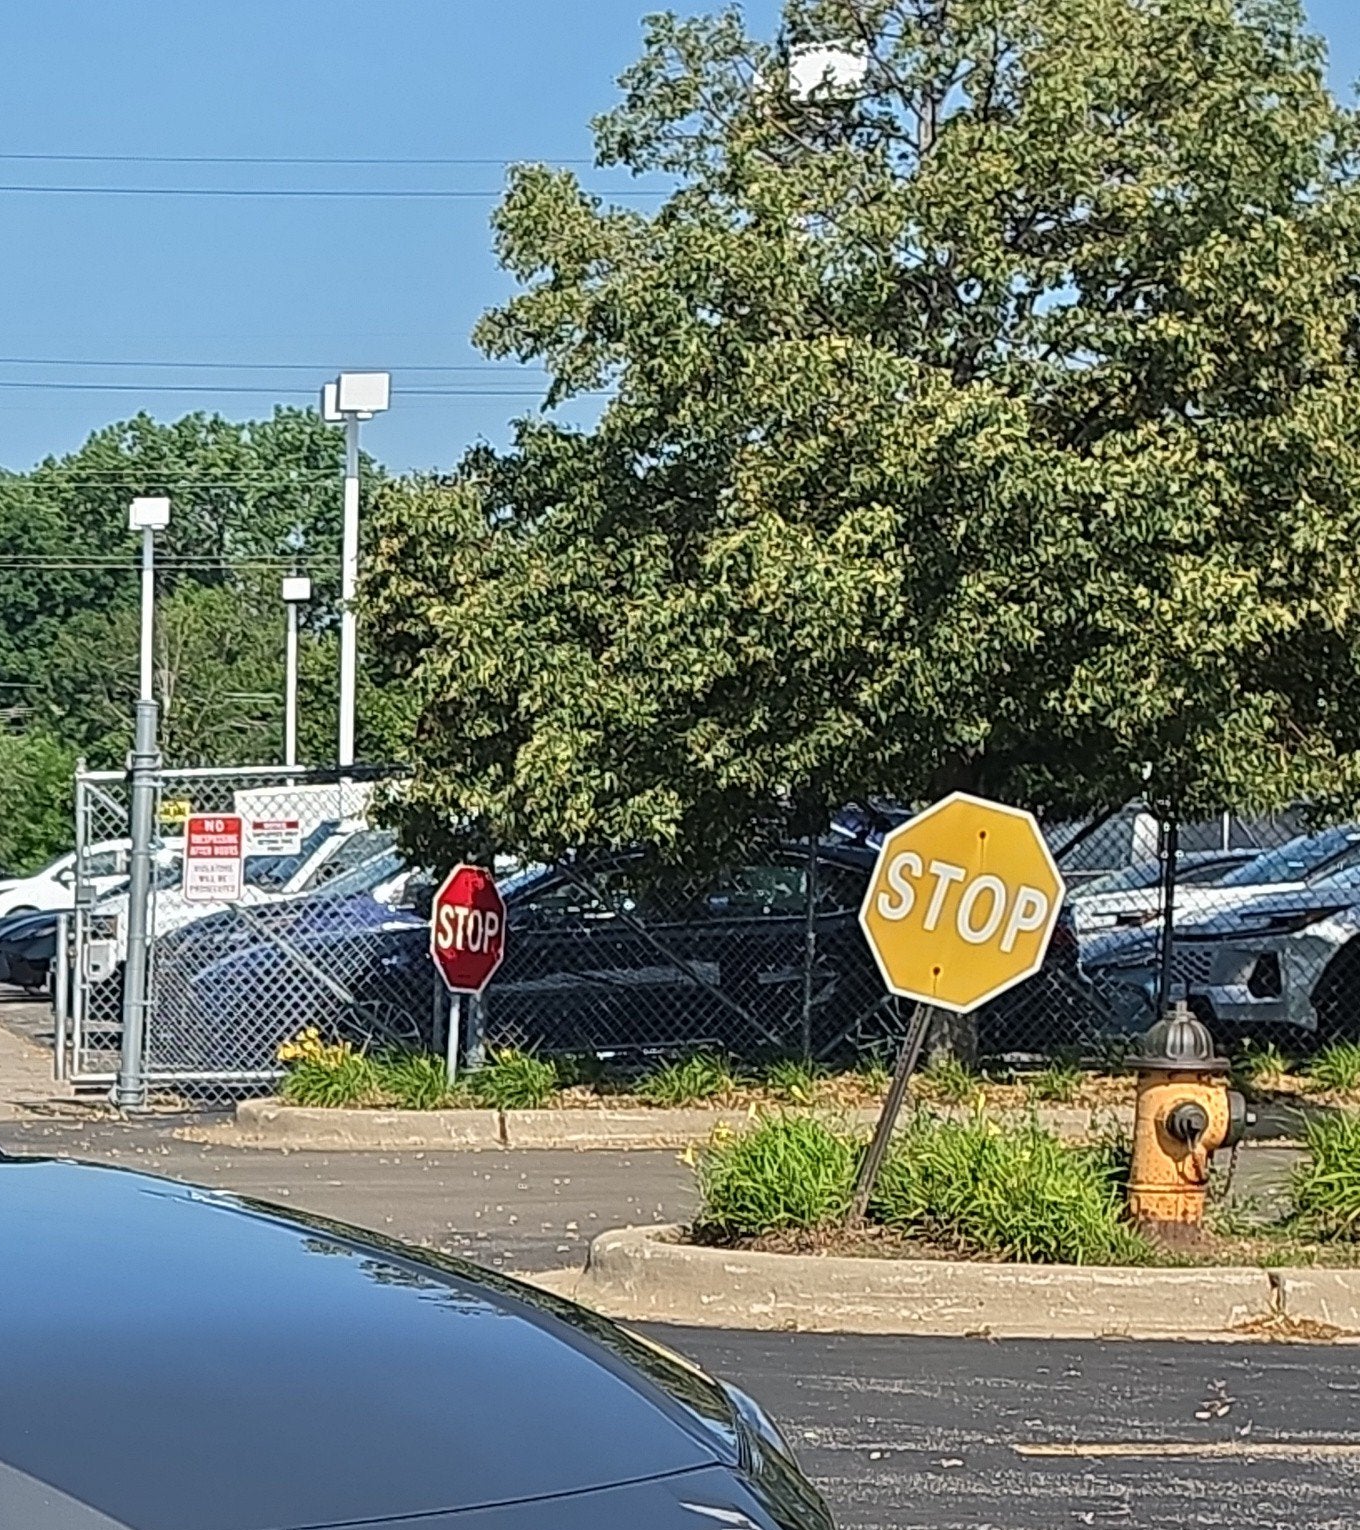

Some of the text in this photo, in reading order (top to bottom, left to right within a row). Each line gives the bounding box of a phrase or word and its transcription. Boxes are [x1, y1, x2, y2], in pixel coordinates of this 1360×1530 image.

[204, 819, 225, 832] NO
[877, 850, 1049, 954] STOP
[437, 903, 499, 954] STOP
